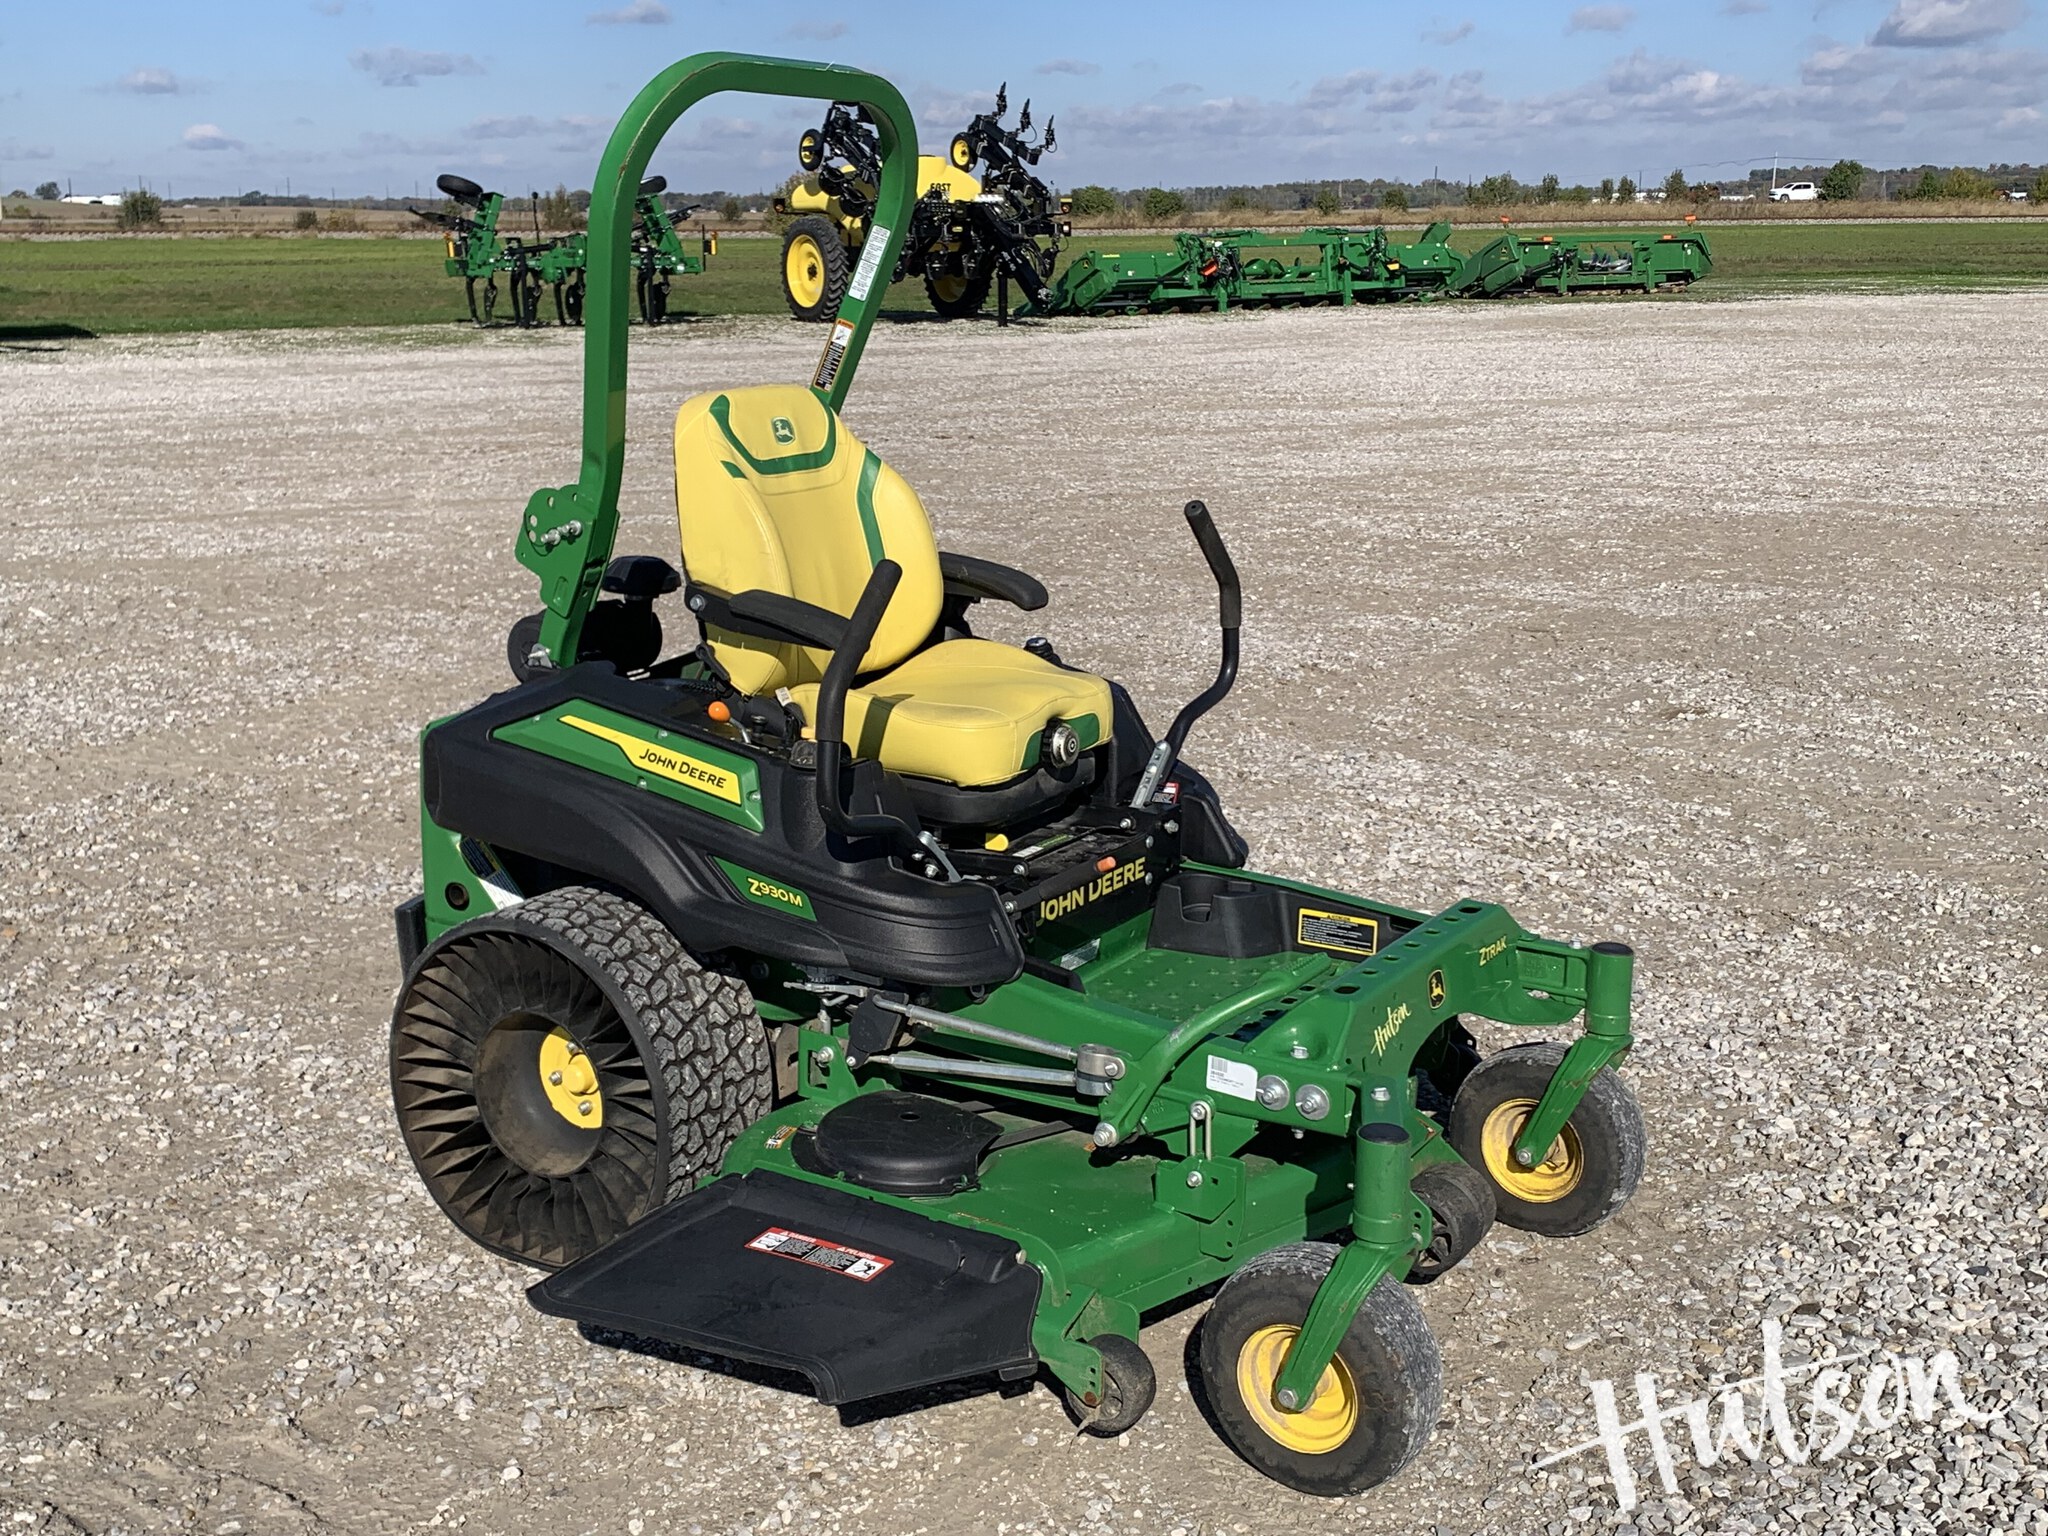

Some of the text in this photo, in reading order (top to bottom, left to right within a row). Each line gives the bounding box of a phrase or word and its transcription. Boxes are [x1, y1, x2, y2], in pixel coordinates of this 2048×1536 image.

[930, 183, 951, 191] FAST
[639, 748, 728, 789] JOHN DEERE
[747, 877, 803, 907] Z930M
[1036, 857, 1146, 927] JOHN DEERE
[1479, 935, 1507, 966] ZTRAK
[1370, 1002, 1412, 1057] Hutson
